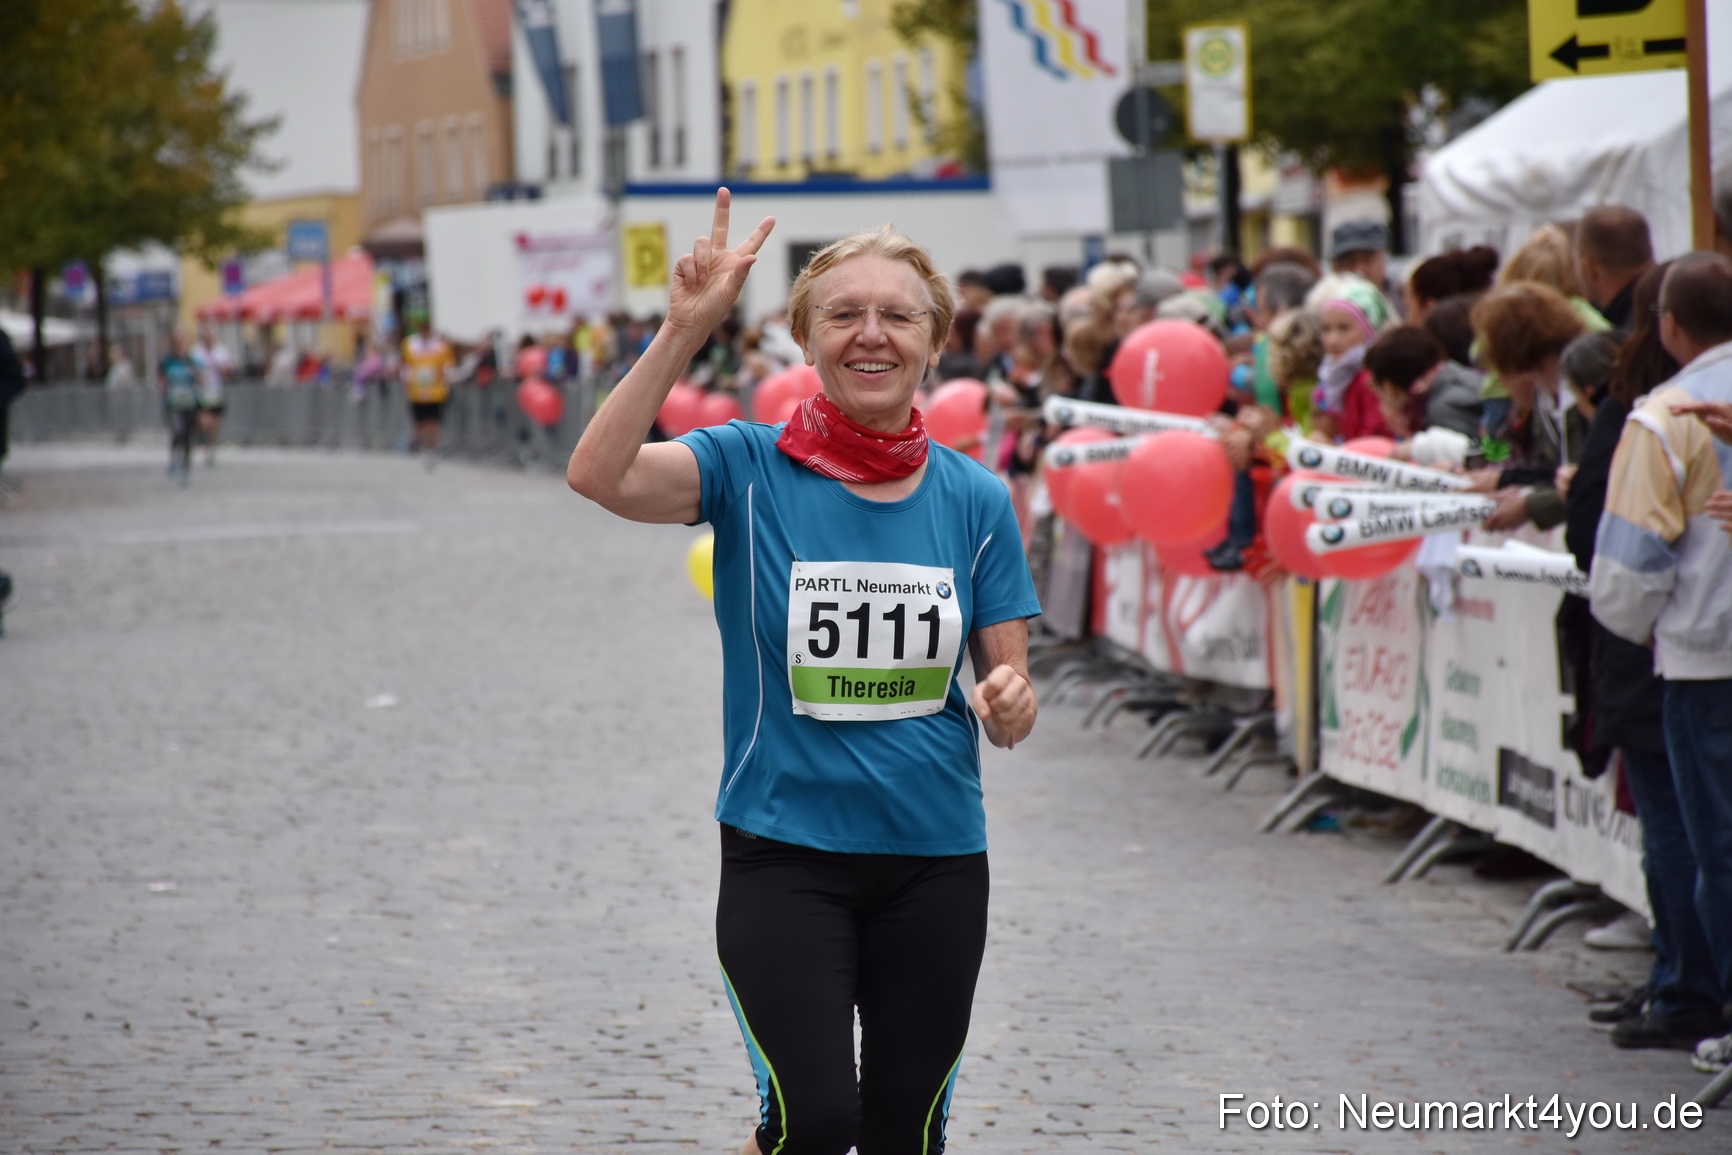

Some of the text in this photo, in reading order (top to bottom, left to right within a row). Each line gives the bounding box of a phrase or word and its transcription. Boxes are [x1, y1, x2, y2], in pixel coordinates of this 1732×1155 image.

[1336, 456, 1392, 484] BMW
[1359, 516, 1415, 539] BMW
[794, 577, 931, 596] PARTL Neumarkt
[807, 601, 941, 660] 5111
[795, 653, 802, 664] S
[827, 675, 916, 699] Theresia
